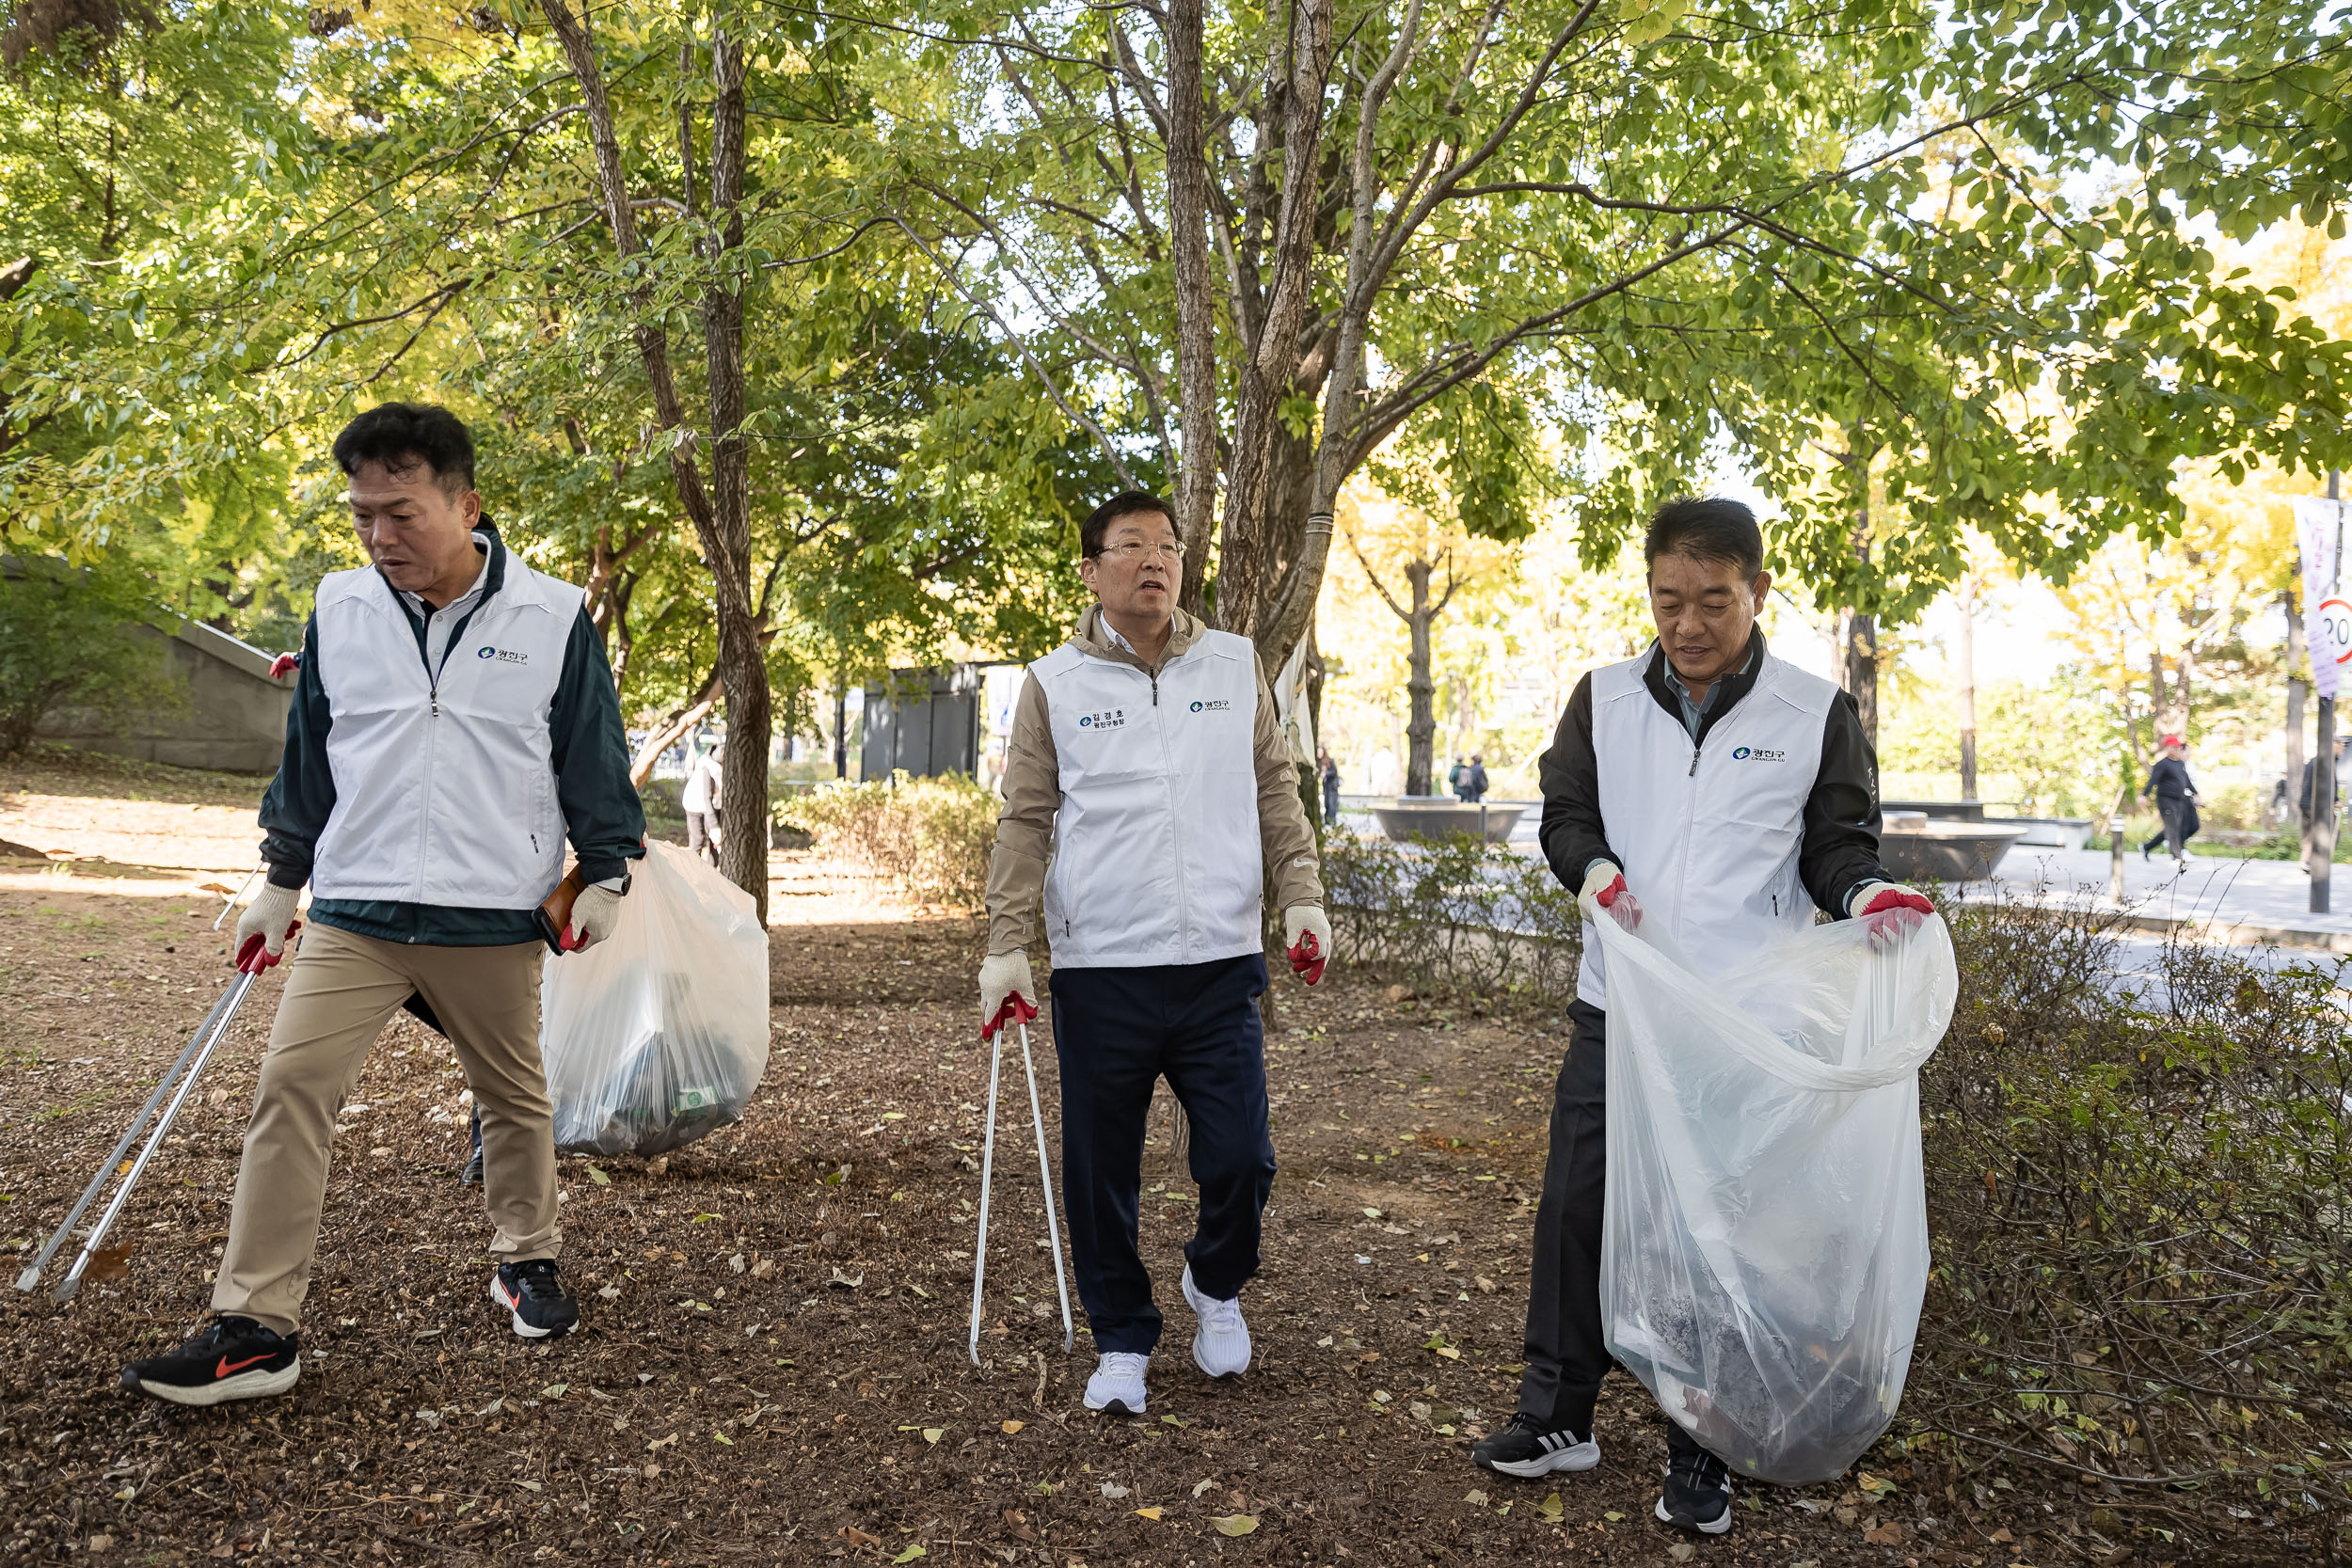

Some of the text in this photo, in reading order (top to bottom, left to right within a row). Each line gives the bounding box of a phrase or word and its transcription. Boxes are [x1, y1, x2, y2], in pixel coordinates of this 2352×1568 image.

[498, 649, 528, 660] 광진구
[1204, 700, 1229, 708] 광진구
[1752, 748, 1786, 758] 광진구
